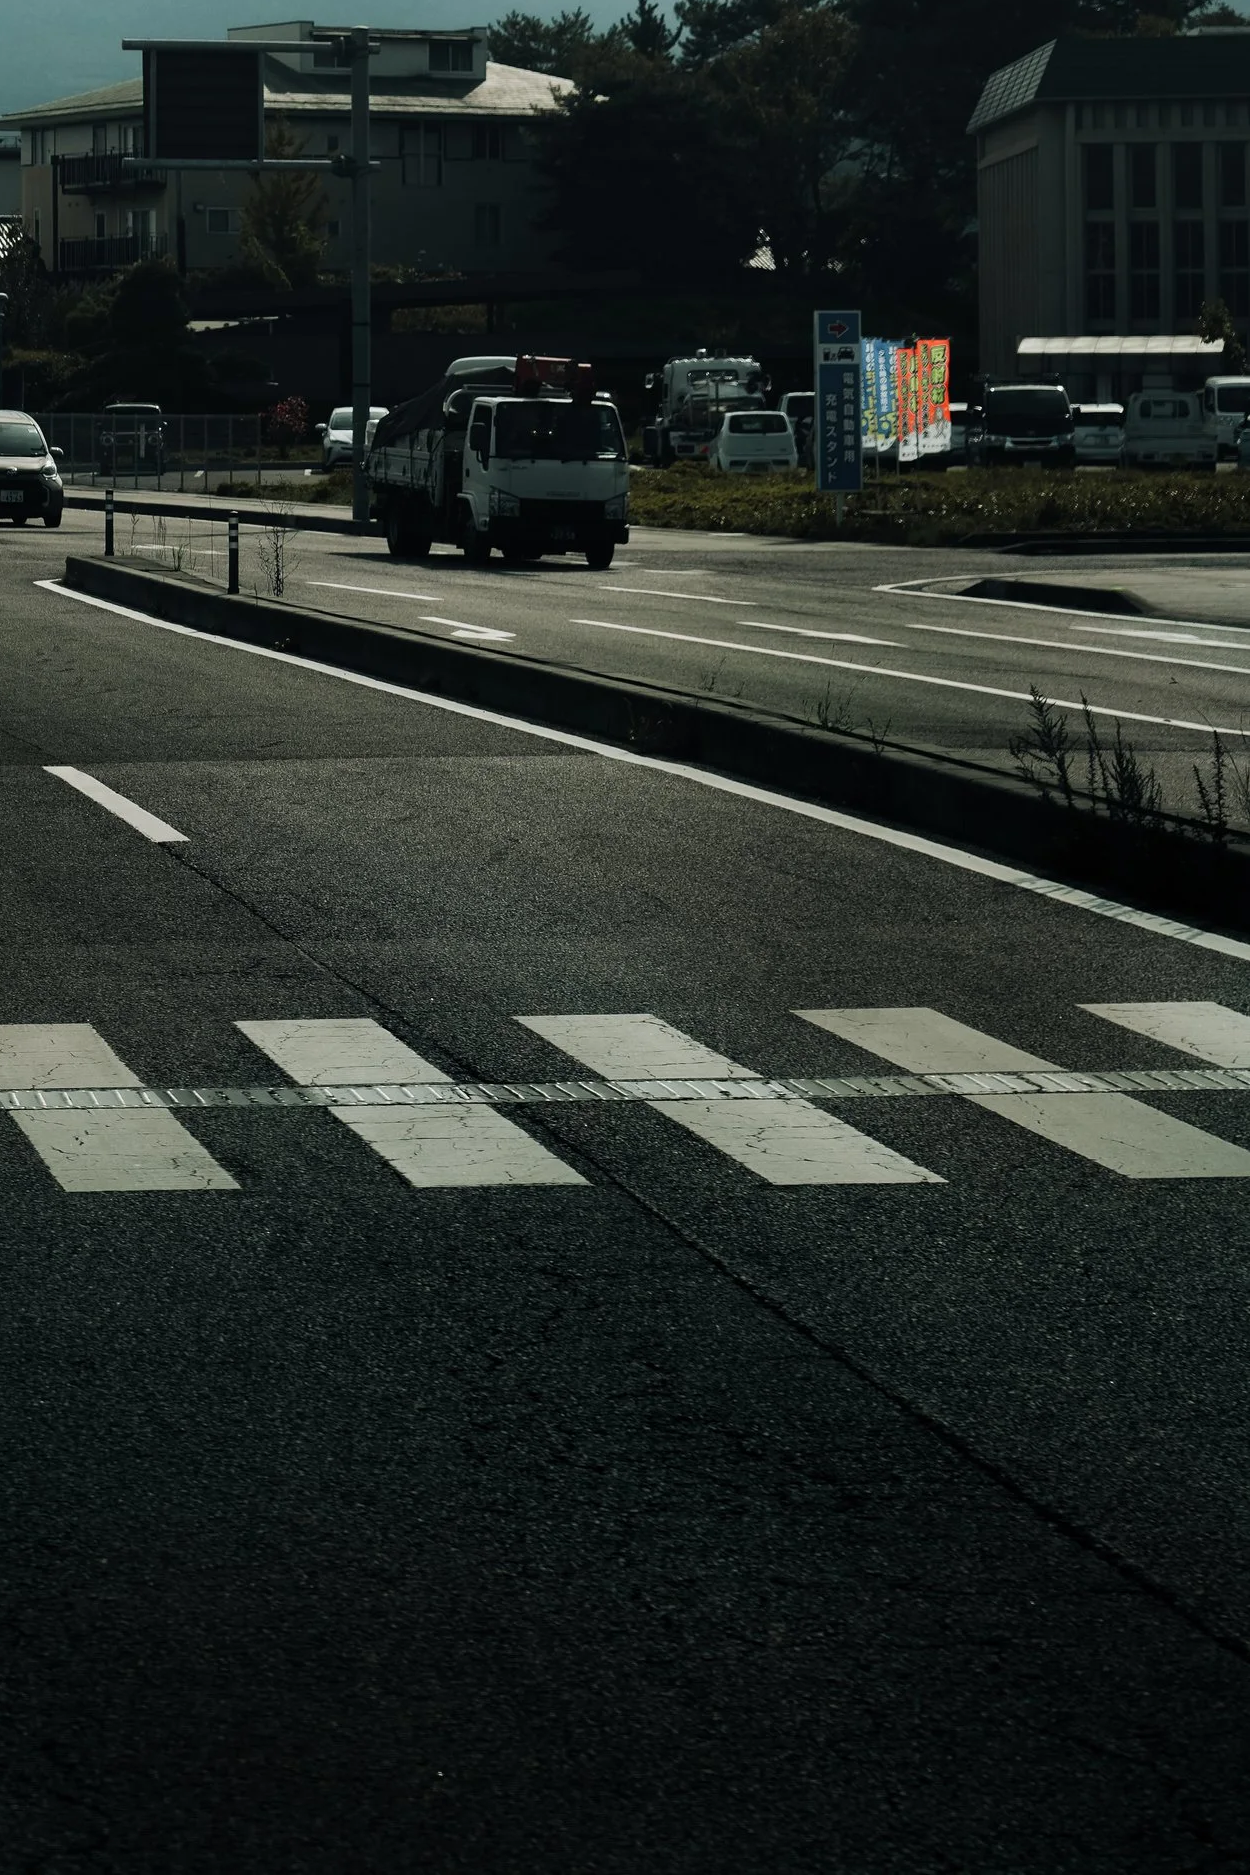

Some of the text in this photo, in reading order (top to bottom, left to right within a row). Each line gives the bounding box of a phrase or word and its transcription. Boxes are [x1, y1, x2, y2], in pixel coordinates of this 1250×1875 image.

[825, 393, 838, 484] 充電スタンド
[842, 372, 856, 464] 電気自動車用
